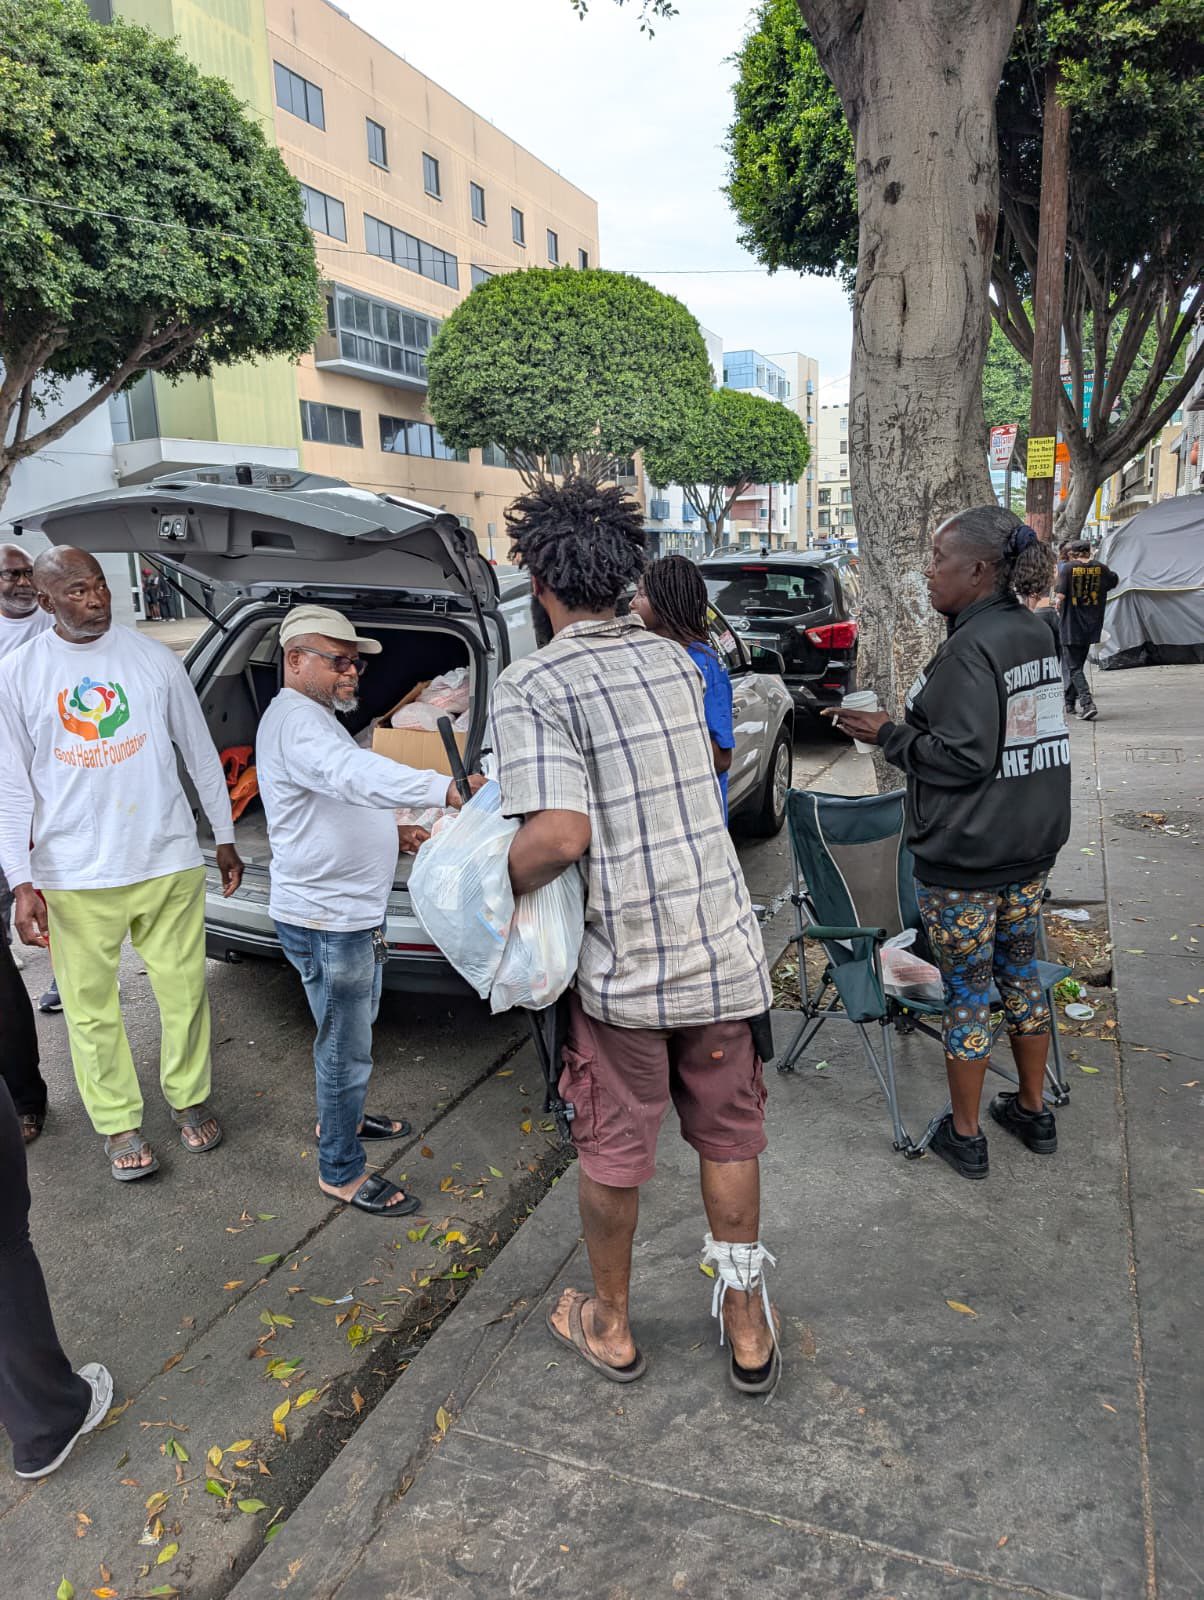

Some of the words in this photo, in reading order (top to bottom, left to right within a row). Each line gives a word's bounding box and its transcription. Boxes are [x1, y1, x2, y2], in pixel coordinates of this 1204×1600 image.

[54, 744, 77, 767] Good
[77, 743, 104, 769] Heart
[102, 733, 147, 766] Foundation
[996, 749, 1030, 778] HE
